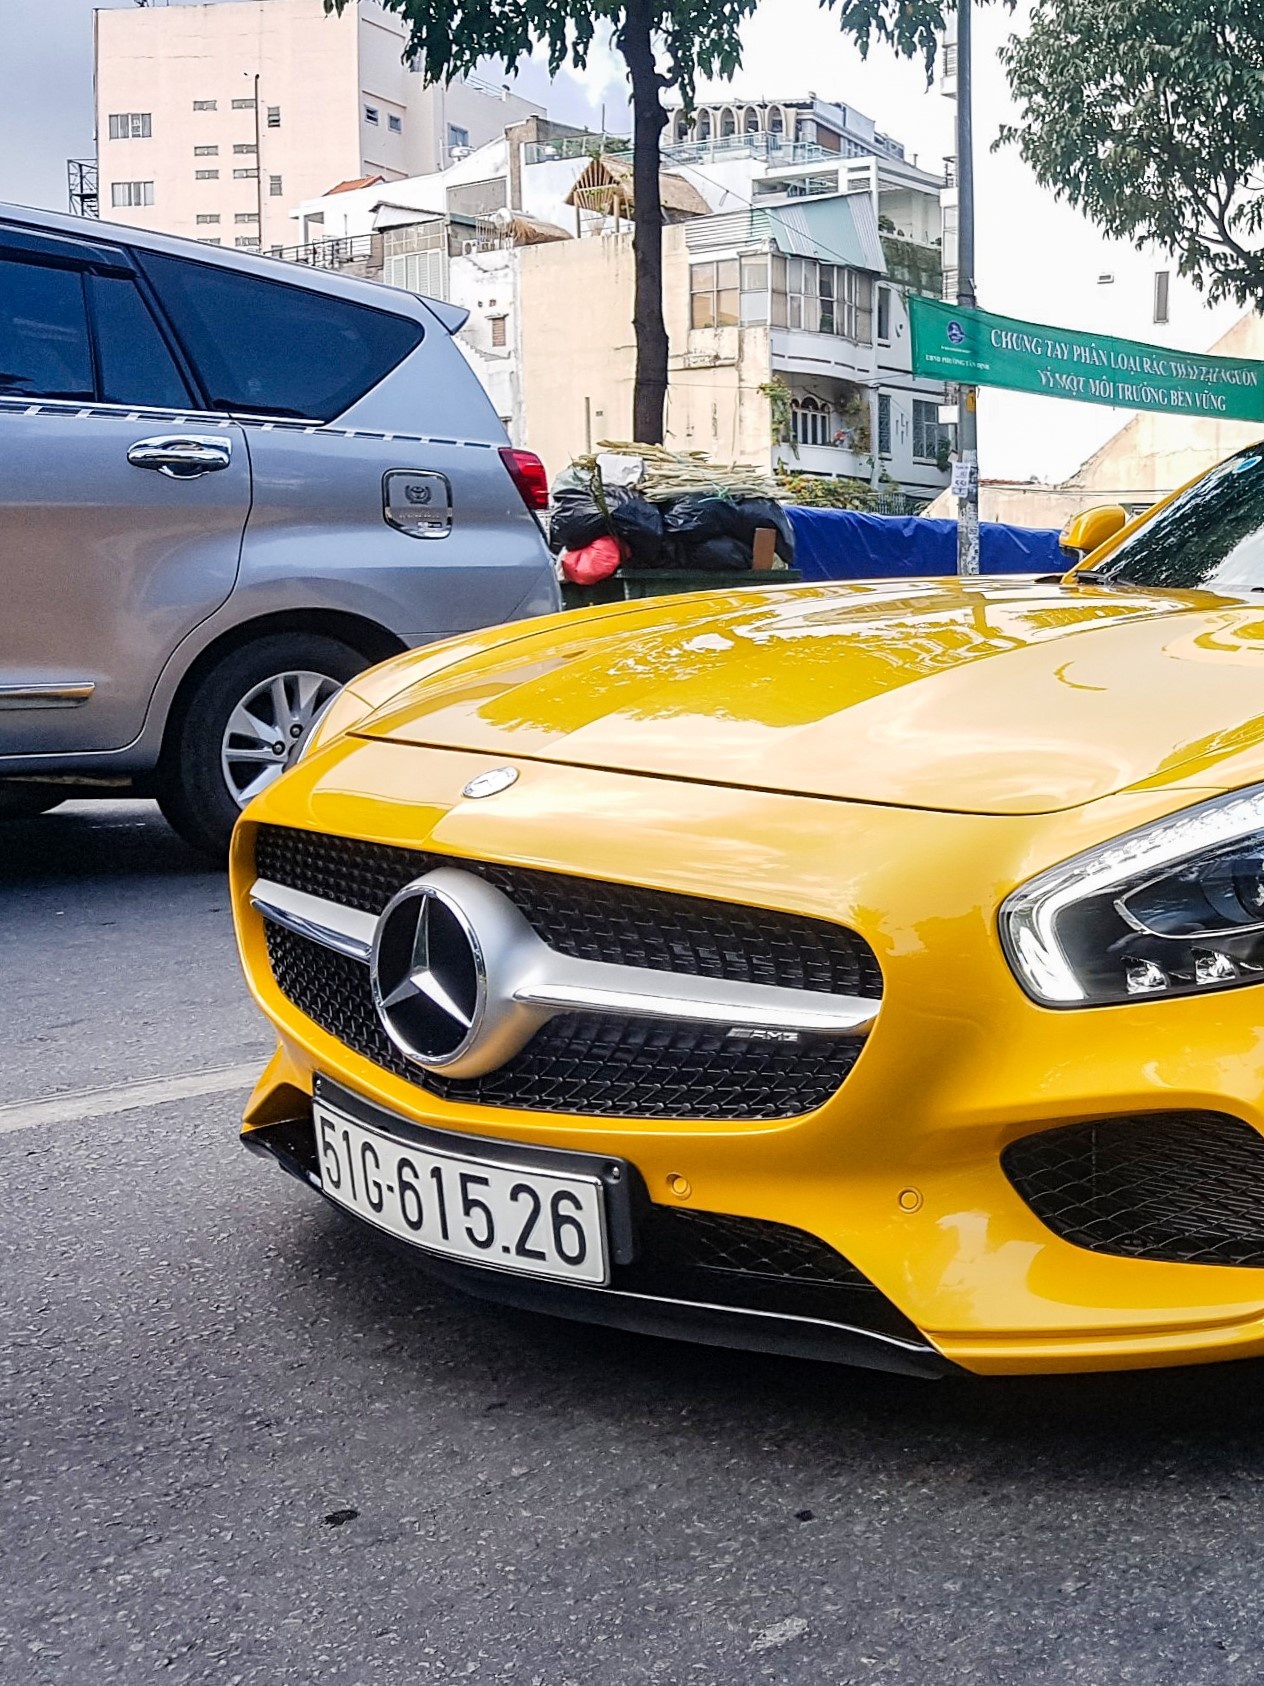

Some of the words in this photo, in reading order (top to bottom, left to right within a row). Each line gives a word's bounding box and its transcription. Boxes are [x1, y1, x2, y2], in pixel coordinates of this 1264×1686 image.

[991, 329, 1042, 355] CHUNG
[1045, 340, 1069, 360] TAY
[1073, 343, 1108, 366] PHÂN
[1111, 351, 1140, 376] LOẠI
[1143, 355, 1169, 377] RÁC
[1055, 372, 1085, 396] MỘT
[1088, 375, 1114, 399] MÔI
[1116, 381, 1168, 405] TRƯỜNG
[1194, 389, 1226, 411] VỮNG
[319, 1115, 587, 1266] 51G-615.26
